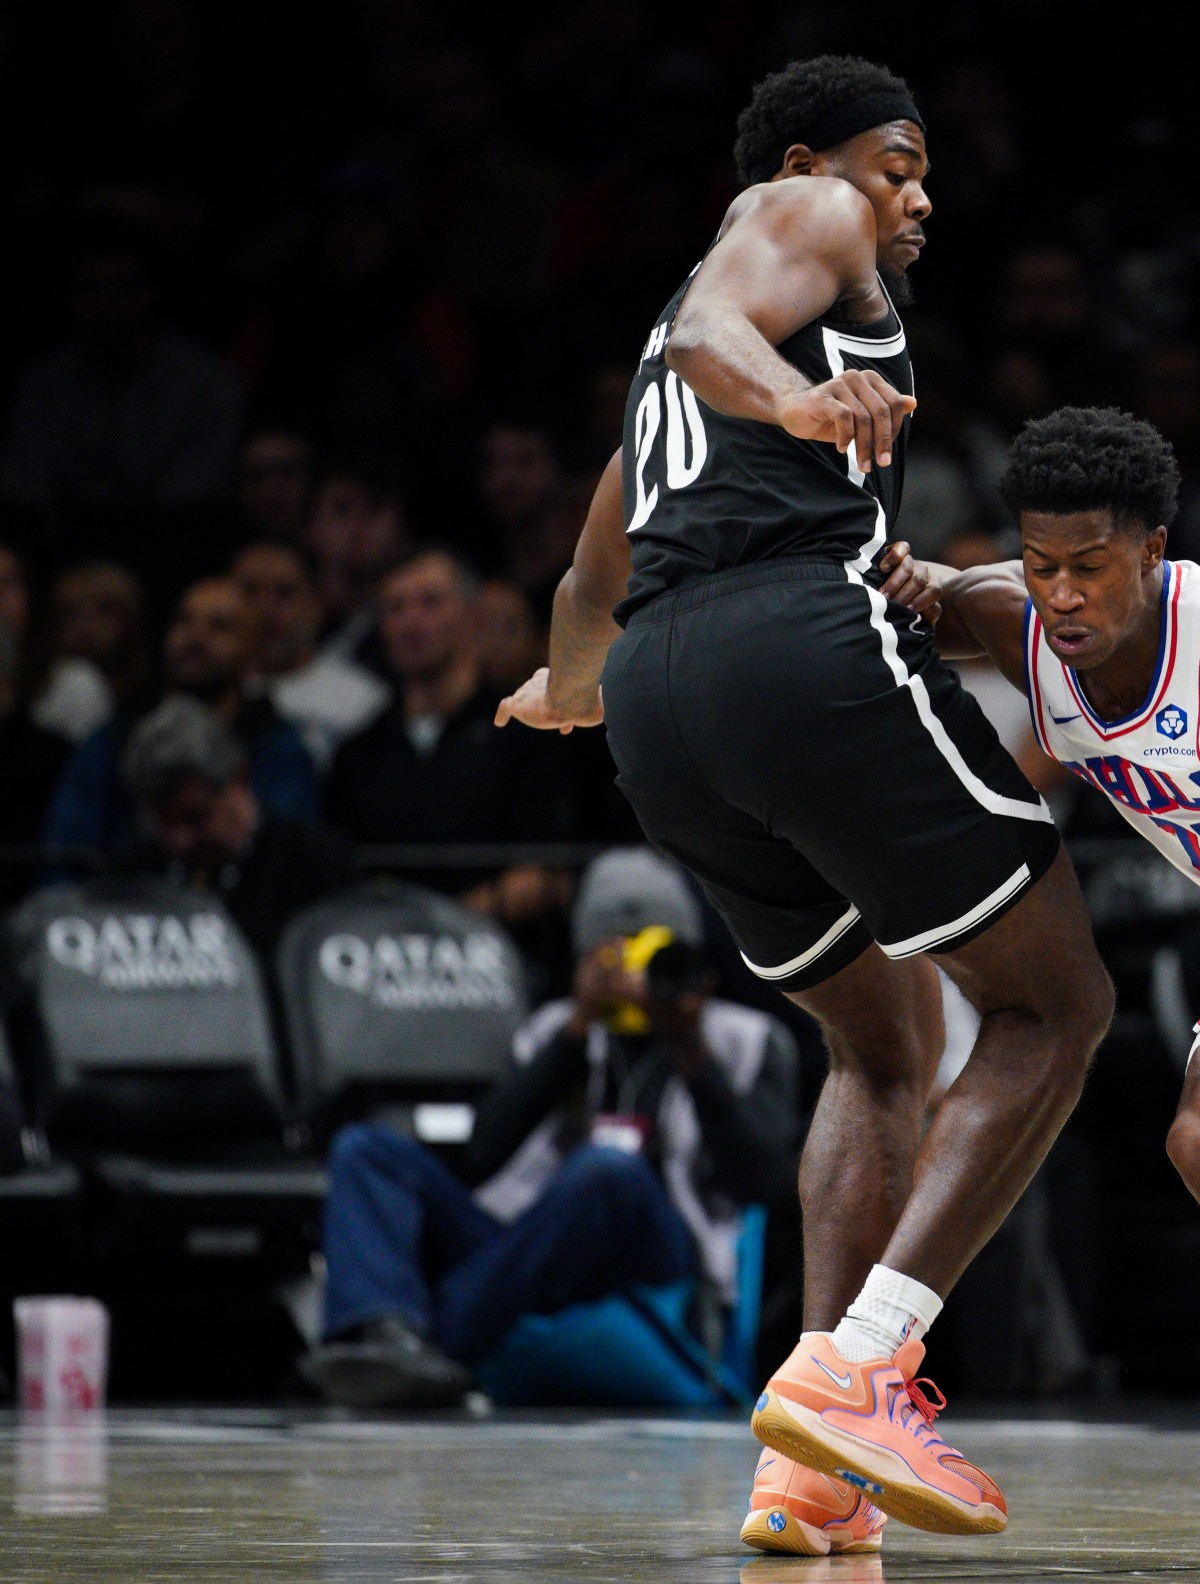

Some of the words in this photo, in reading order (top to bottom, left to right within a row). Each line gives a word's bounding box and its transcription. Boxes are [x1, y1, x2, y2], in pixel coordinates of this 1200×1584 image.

[625, 369, 707, 533] 20
[46, 913, 229, 974] QATAR
[318, 932, 502, 992] QATAR
